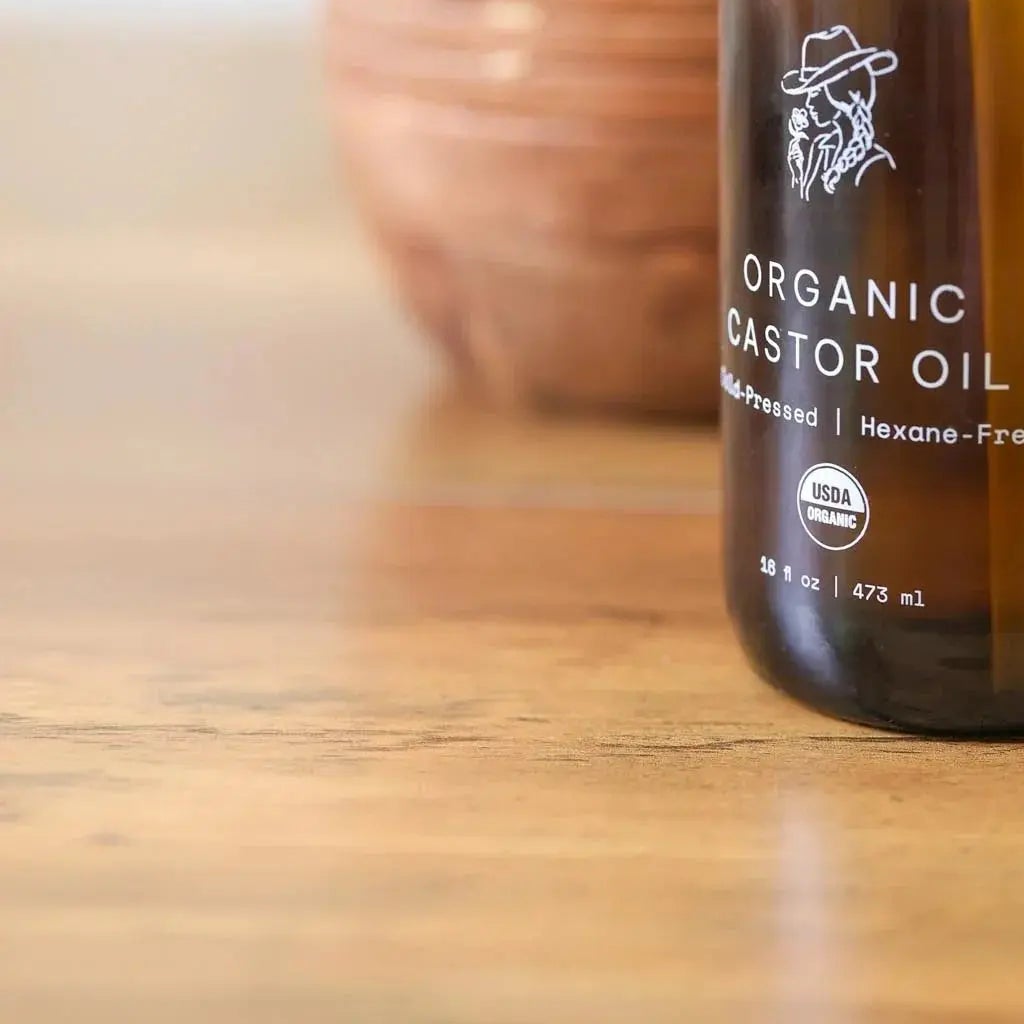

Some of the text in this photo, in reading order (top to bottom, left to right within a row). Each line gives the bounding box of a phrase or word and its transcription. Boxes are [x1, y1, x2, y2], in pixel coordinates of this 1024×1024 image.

[743, 253, 966, 324] ORGANIC
[726, 307, 1010, 391] CASTOR OIL
[812, 482, 851, 506] USDA
[807, 505, 857, 529] ORGANIC
[783, 565, 792, 583] fl
[801, 574, 820, 591] oz
[852, 582, 888, 603] 473
[900, 590, 925, 607] ml
